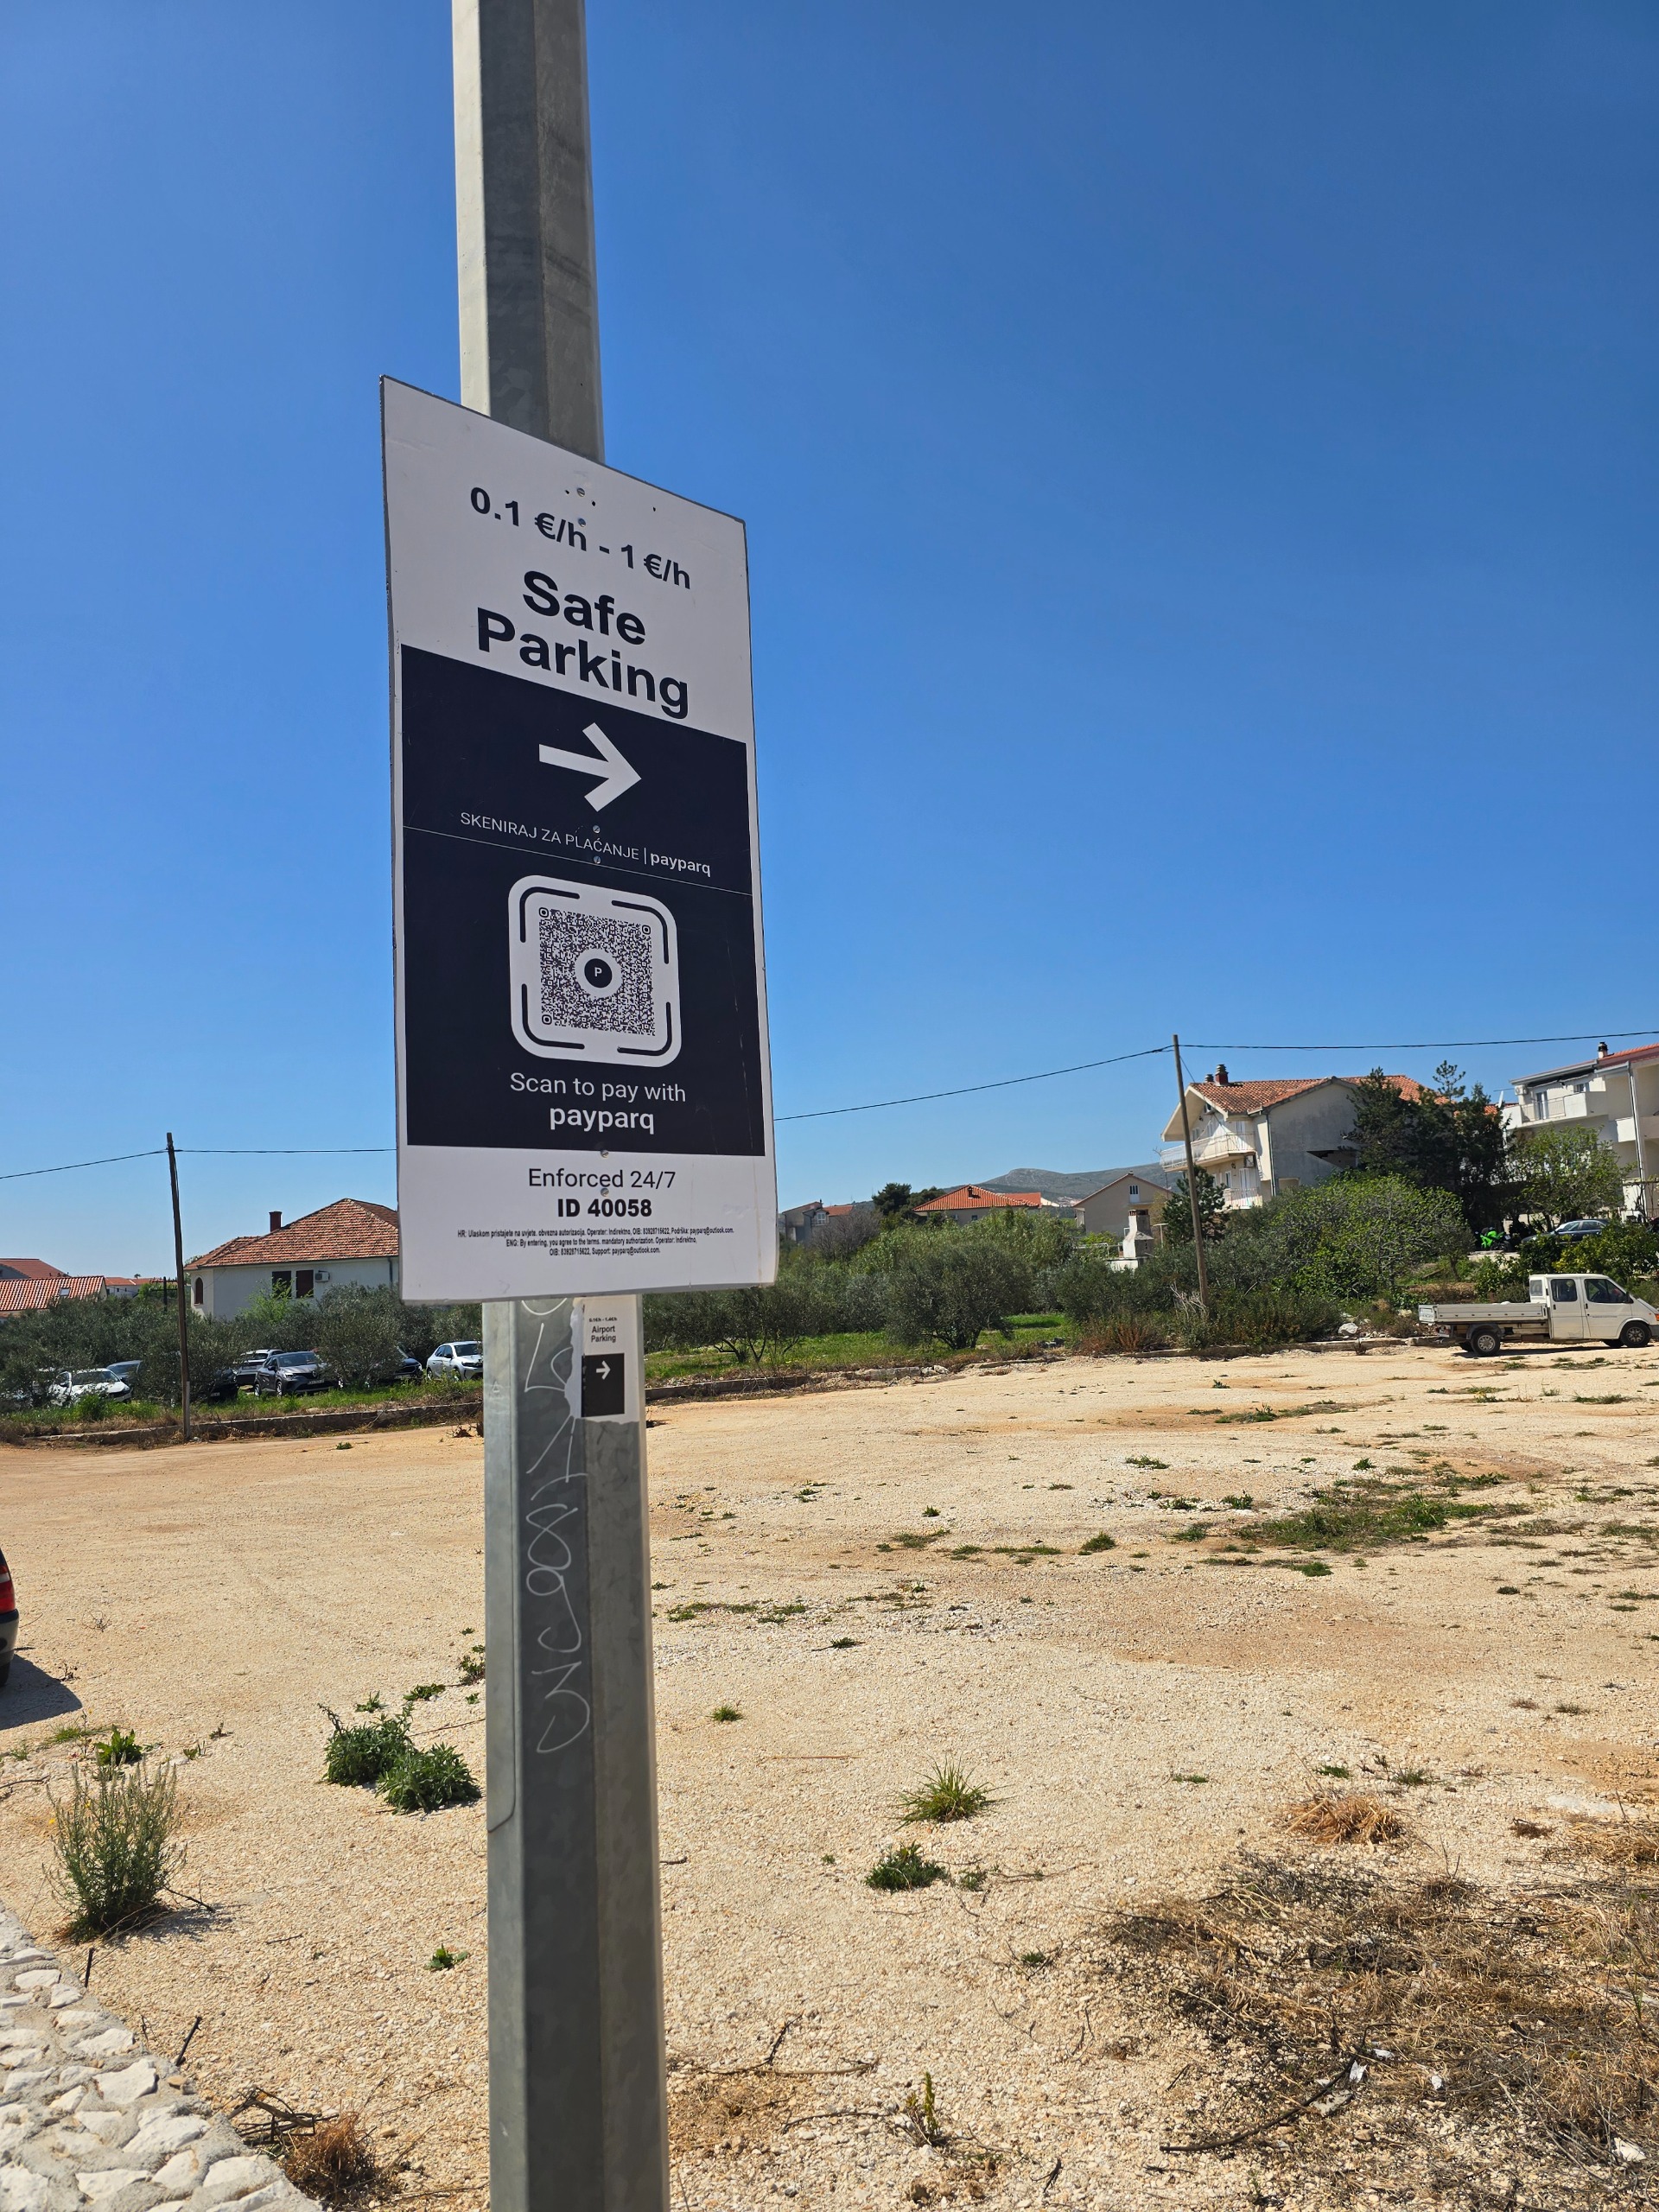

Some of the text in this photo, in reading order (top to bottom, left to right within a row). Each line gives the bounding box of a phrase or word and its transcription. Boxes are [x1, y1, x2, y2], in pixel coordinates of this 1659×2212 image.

[470, 486, 519, 527] 0.1
[534, 512, 587, 552] €/h
[620, 543, 634, 569] 1
[643, 553, 690, 590] €/h
[522, 570, 646, 645] Safe
[477, 607, 689, 720] Parking
[460, 811, 537, 839] SKENIRAJ
[541, 828, 562, 844] ZA
[565, 833, 639, 861] PLAĆANJE
[650, 853, 711, 878] payparq
[594, 967, 602, 977] P
[510, 1072, 686, 1103] Scan to pay with
[550, 1108, 654, 1135] payparq
[529, 1167, 676, 1190] Enforced 24/7
[557, 1198, 652, 1217] ID 40058
[491, 1229, 513, 1239] pristajete
[587, 1228, 607, 1236] Operater:
[506, 1238, 518, 1247] ENG:
[519, 1238, 526, 1248] By
[601, 1237, 625, 1246] mandatory
[549, 1248, 560, 1256] OIB:
[592, 1247, 611, 1255] Support:
[591, 1325, 615, 1334] Airport
[591, 1334, 616, 1343] Parking
